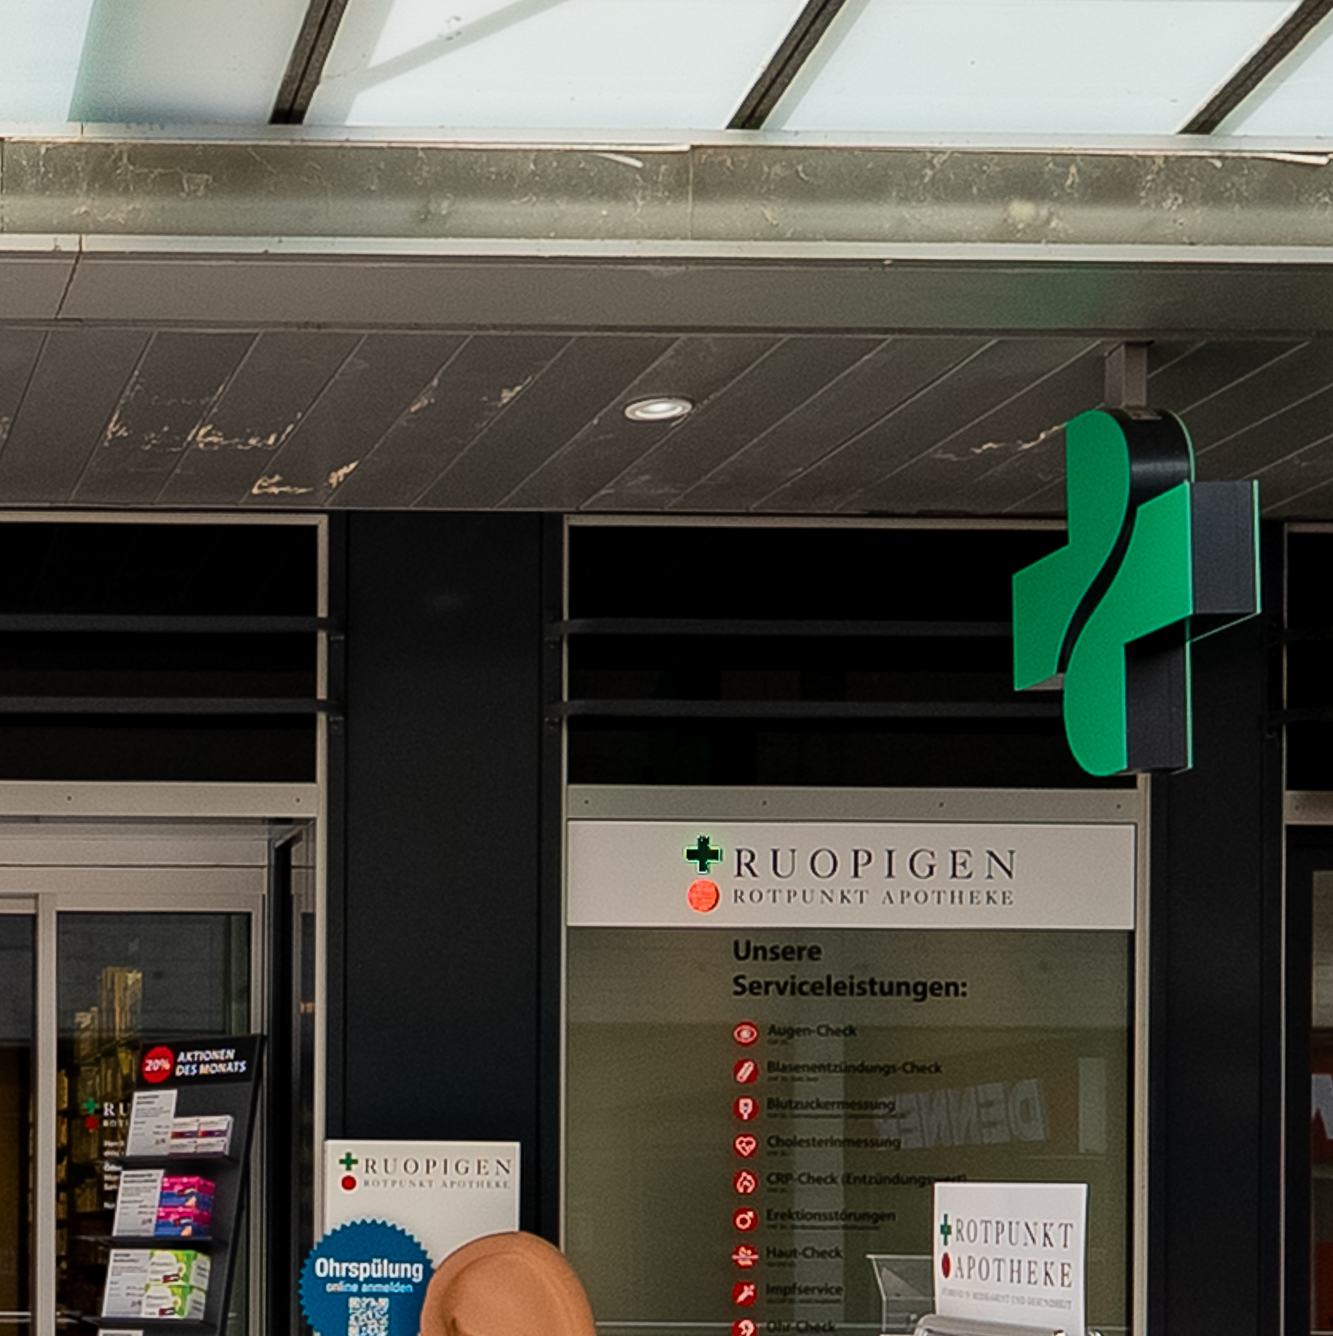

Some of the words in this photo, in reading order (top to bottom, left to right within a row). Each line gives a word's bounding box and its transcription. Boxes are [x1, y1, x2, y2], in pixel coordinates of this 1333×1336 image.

[734, 848, 1018, 879] RUOPIGEN
[734, 889, 870, 905] ROTPUNKT
[882, 889, 1014, 906] APOTHEKE
[734, 939, 822, 961] Unsere
[733, 976, 968, 1001] Serviceleistungen:
[767, 1024, 857, 1039] Augen-Check
[177, 1049, 235, 1063] AKTIONEN
[144, 1056, 171, 1072] 20%
[175, 1063, 198, 1077] DES
[199, 1060, 247, 1076] MONATS
[767, 1060, 943, 1076] Blasenentzündungs-Check
[103, 1101, 131, 1116] RU
[767, 1097, 896, 1112] Blutzuckermessung
[767, 1135, 901, 1150] Cholesterinmessung
[364, 1157, 512, 1175] RUOPIGEN
[363, 1178, 434, 1188] ROTPUNKT
[440, 1179, 512, 1190] APOTHEKE
[766, 1172, 838, 1185] CRP-Check
[766, 1209, 897, 1224] Erektionsstörungen
[955, 1218, 1074, 1249] ROTPUNKT
[766, 1247, 843, 1259] Haut-Check
[314, 1257, 424, 1283] Ohrspülung
[954, 1255, 1073, 1289] APOTHEKE
[326, 1282, 359, 1293] online
[361, 1282, 413, 1293] anmelden
[766, 1285, 843, 1298] Impfservice
[766, 1321, 836, 1333] Ohr-Check
